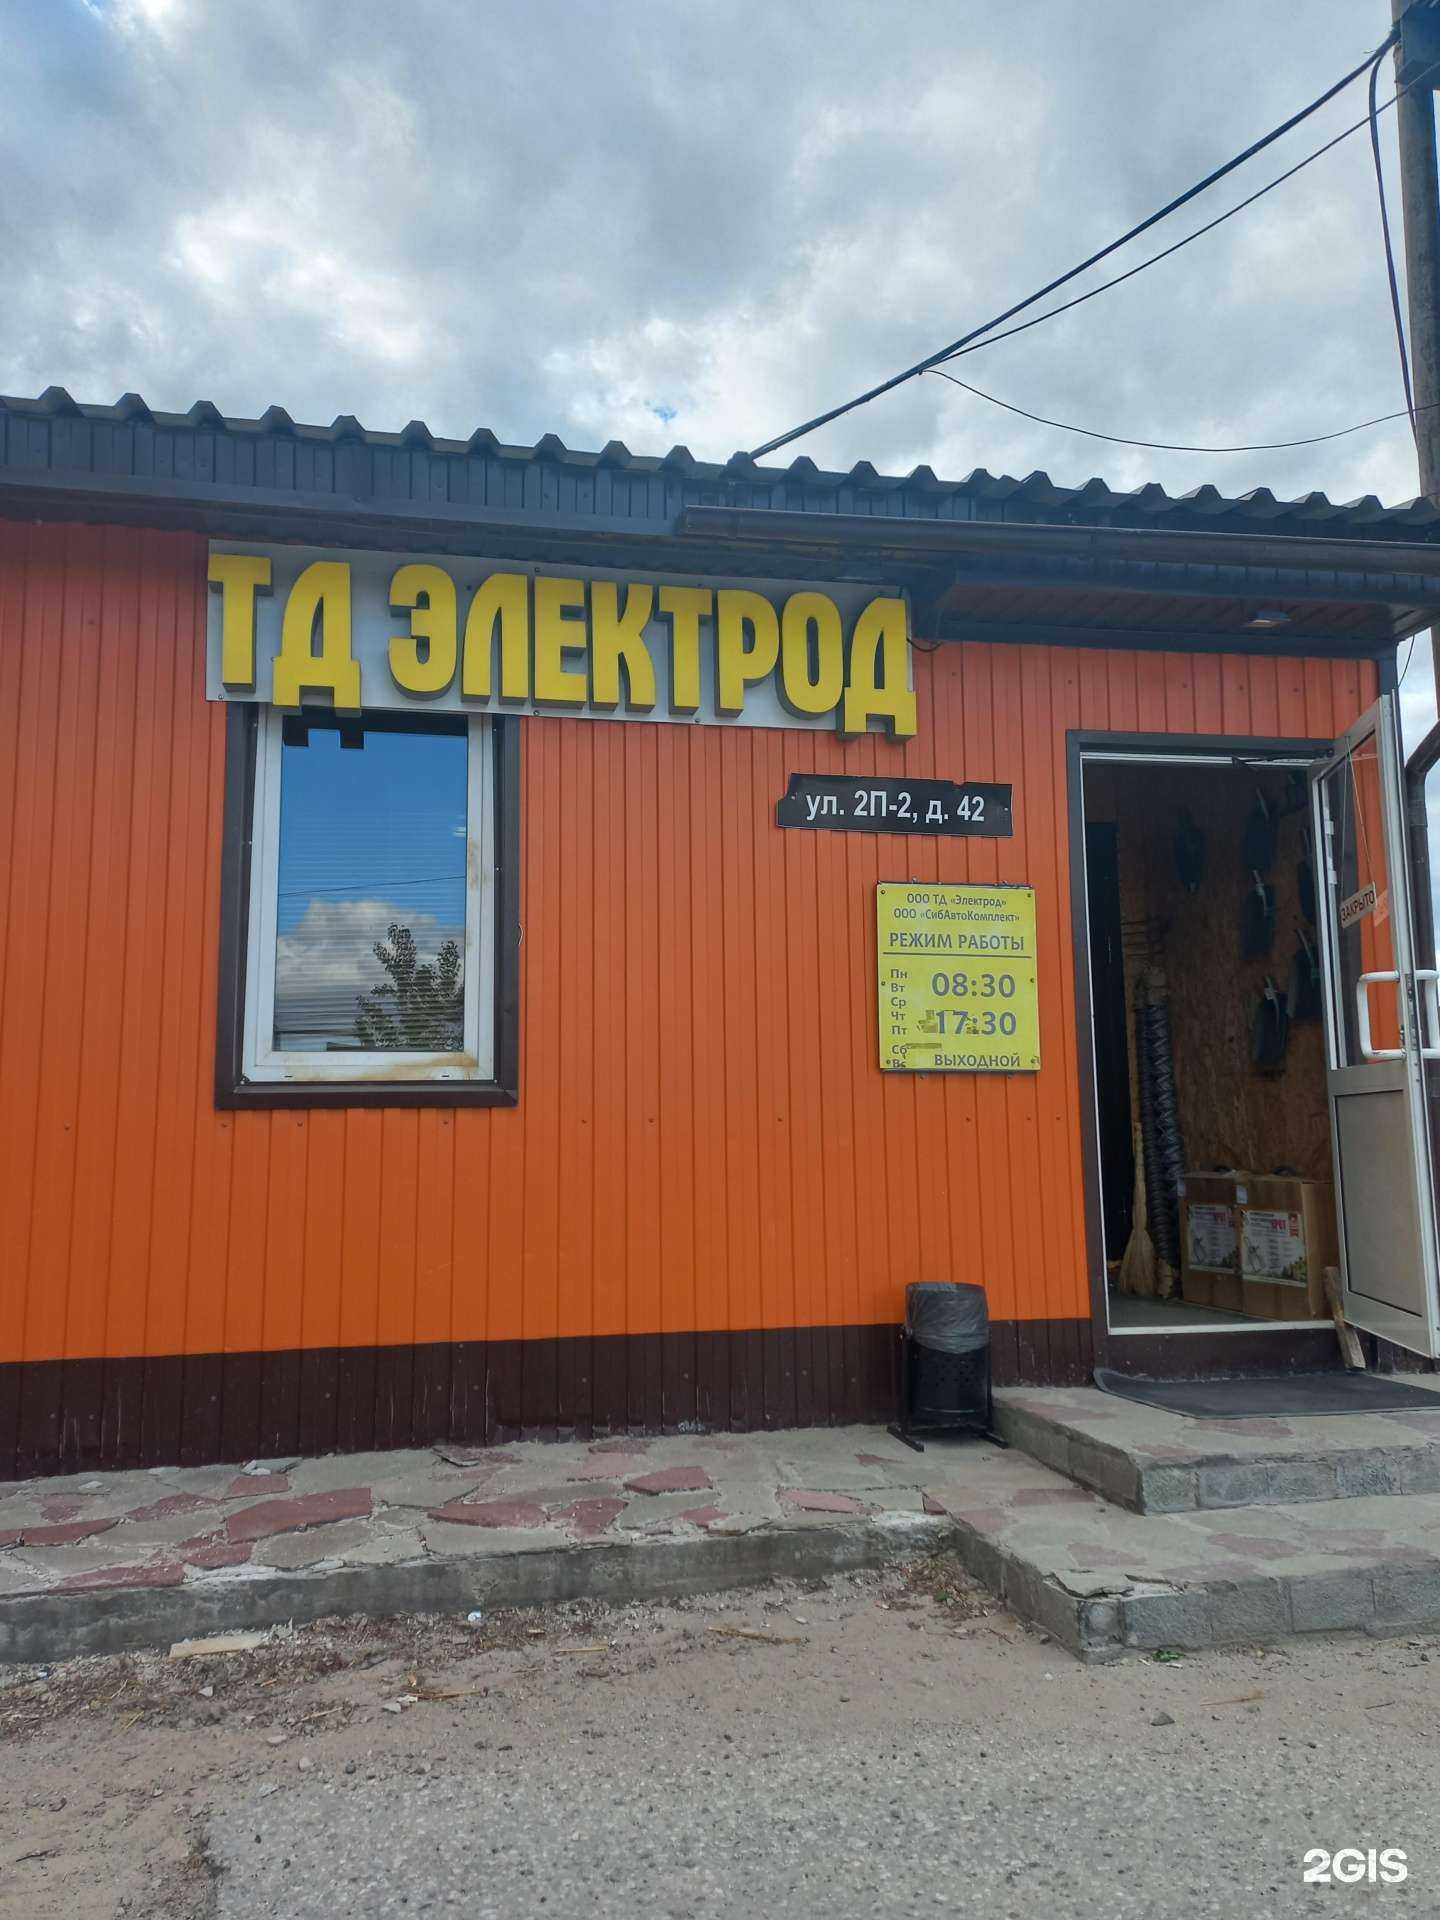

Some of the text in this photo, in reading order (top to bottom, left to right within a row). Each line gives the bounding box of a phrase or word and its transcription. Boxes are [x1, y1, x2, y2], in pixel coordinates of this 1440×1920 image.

[208, 554, 917, 736] ТД ЭЛЕКТРОД
[805, 790, 985, 824] ул. 2П-2, д. 42
[907, 893, 1007, 908] ООО ТД «Электрод»
[1341, 890, 1376, 922] ЗАКРЫТО
[894, 908, 1020, 923] ООО «СибАвтоКомплект»
[889, 932, 1024, 951] РЕЖИМ РАБОТЫ
[890, 969, 908, 979] Пн
[890, 983, 905, 993] Вт
[931, 972, 1016, 998] 08:30
[890, 997, 907, 1009] Ср
[891, 1011, 906, 1021] Чт
[935, 1011, 1017, 1036] 17:30
[891, 1026, 907, 1035] Пт
[891, 1044, 908, 1055] Сб
[892, 1059, 907, 1068] Вс
[934, 1052, 1021, 1068] ВЫХОДНОЙ
